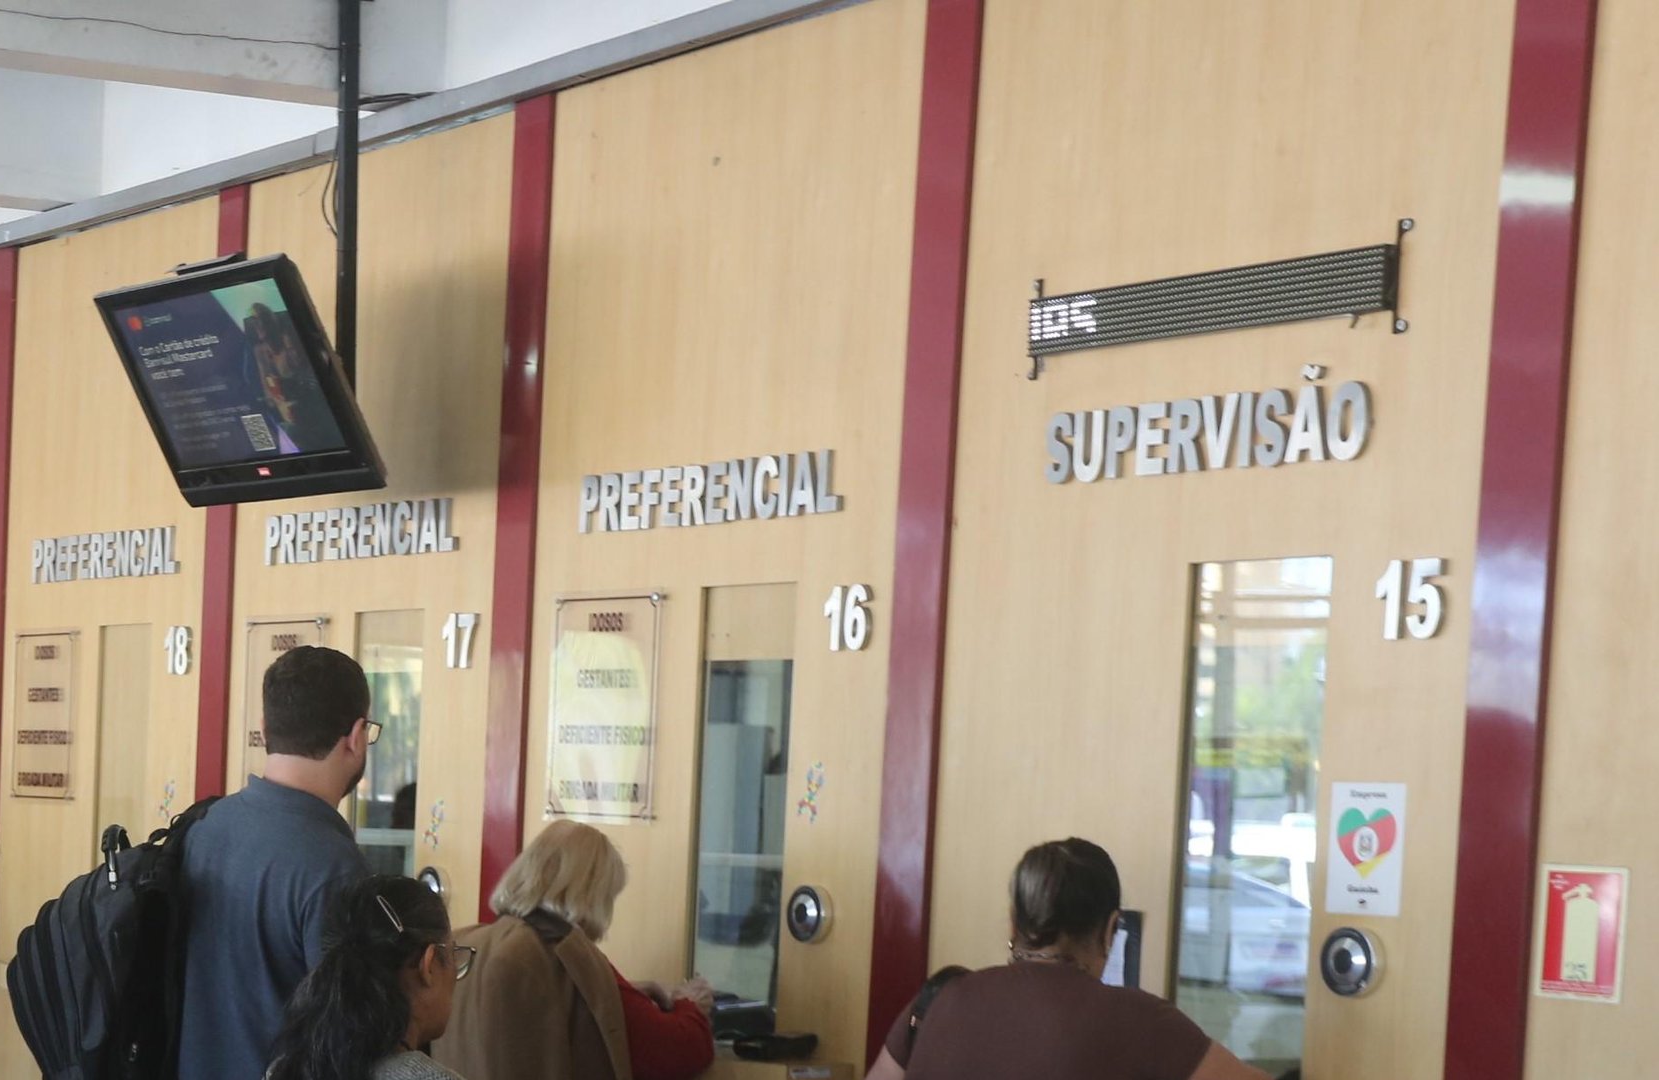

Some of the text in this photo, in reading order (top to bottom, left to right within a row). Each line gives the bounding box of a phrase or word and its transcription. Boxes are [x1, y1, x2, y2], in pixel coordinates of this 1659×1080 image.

[1045, 364, 1373, 484] SUPERVISÃO
[578, 448, 843, 533] PREFERENCIAL
[32, 526, 181, 584] PREFERENCIAL
[264, 498, 459, 566] PREFERENCIAL
[588, 612, 625, 632] IDOSOS
[823, 583, 872, 652] 16
[1375, 557, 1445, 640] 15
[164, 625, 192, 676] 18
[442, 612, 480, 669] 17
